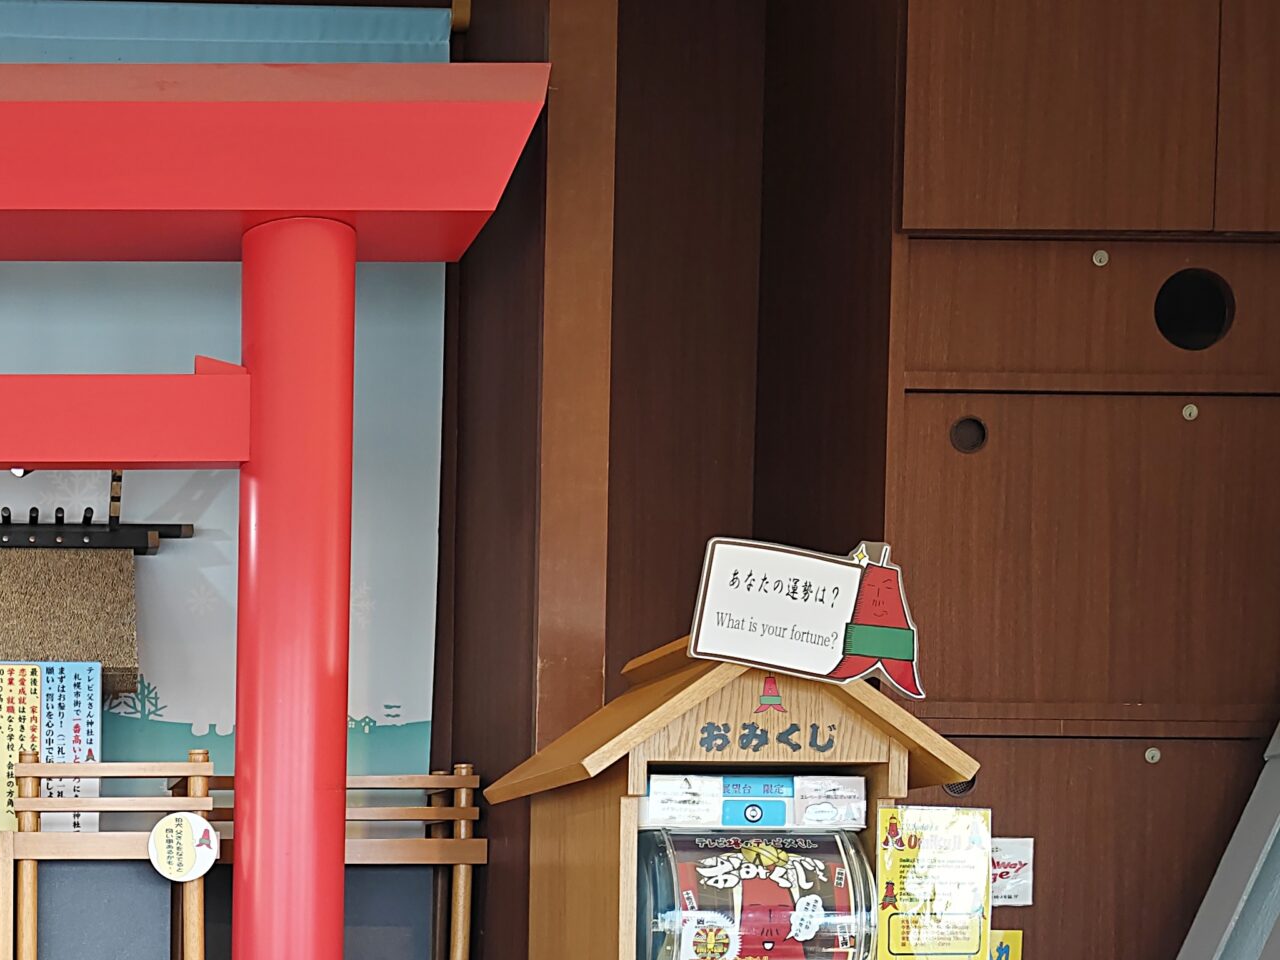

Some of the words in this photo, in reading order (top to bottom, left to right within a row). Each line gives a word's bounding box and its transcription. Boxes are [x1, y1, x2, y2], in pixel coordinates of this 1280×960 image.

[715, 610, 746, 632] What
[748, 616, 758, 633] is
[759, 621, 787, 641] your
[788, 621, 839, 651] fortune?
[86, 666, 96, 745] テレビ父さん神社は
[699, 721, 837, 753] おみくじ
[763, 783, 785, 795] 限定
